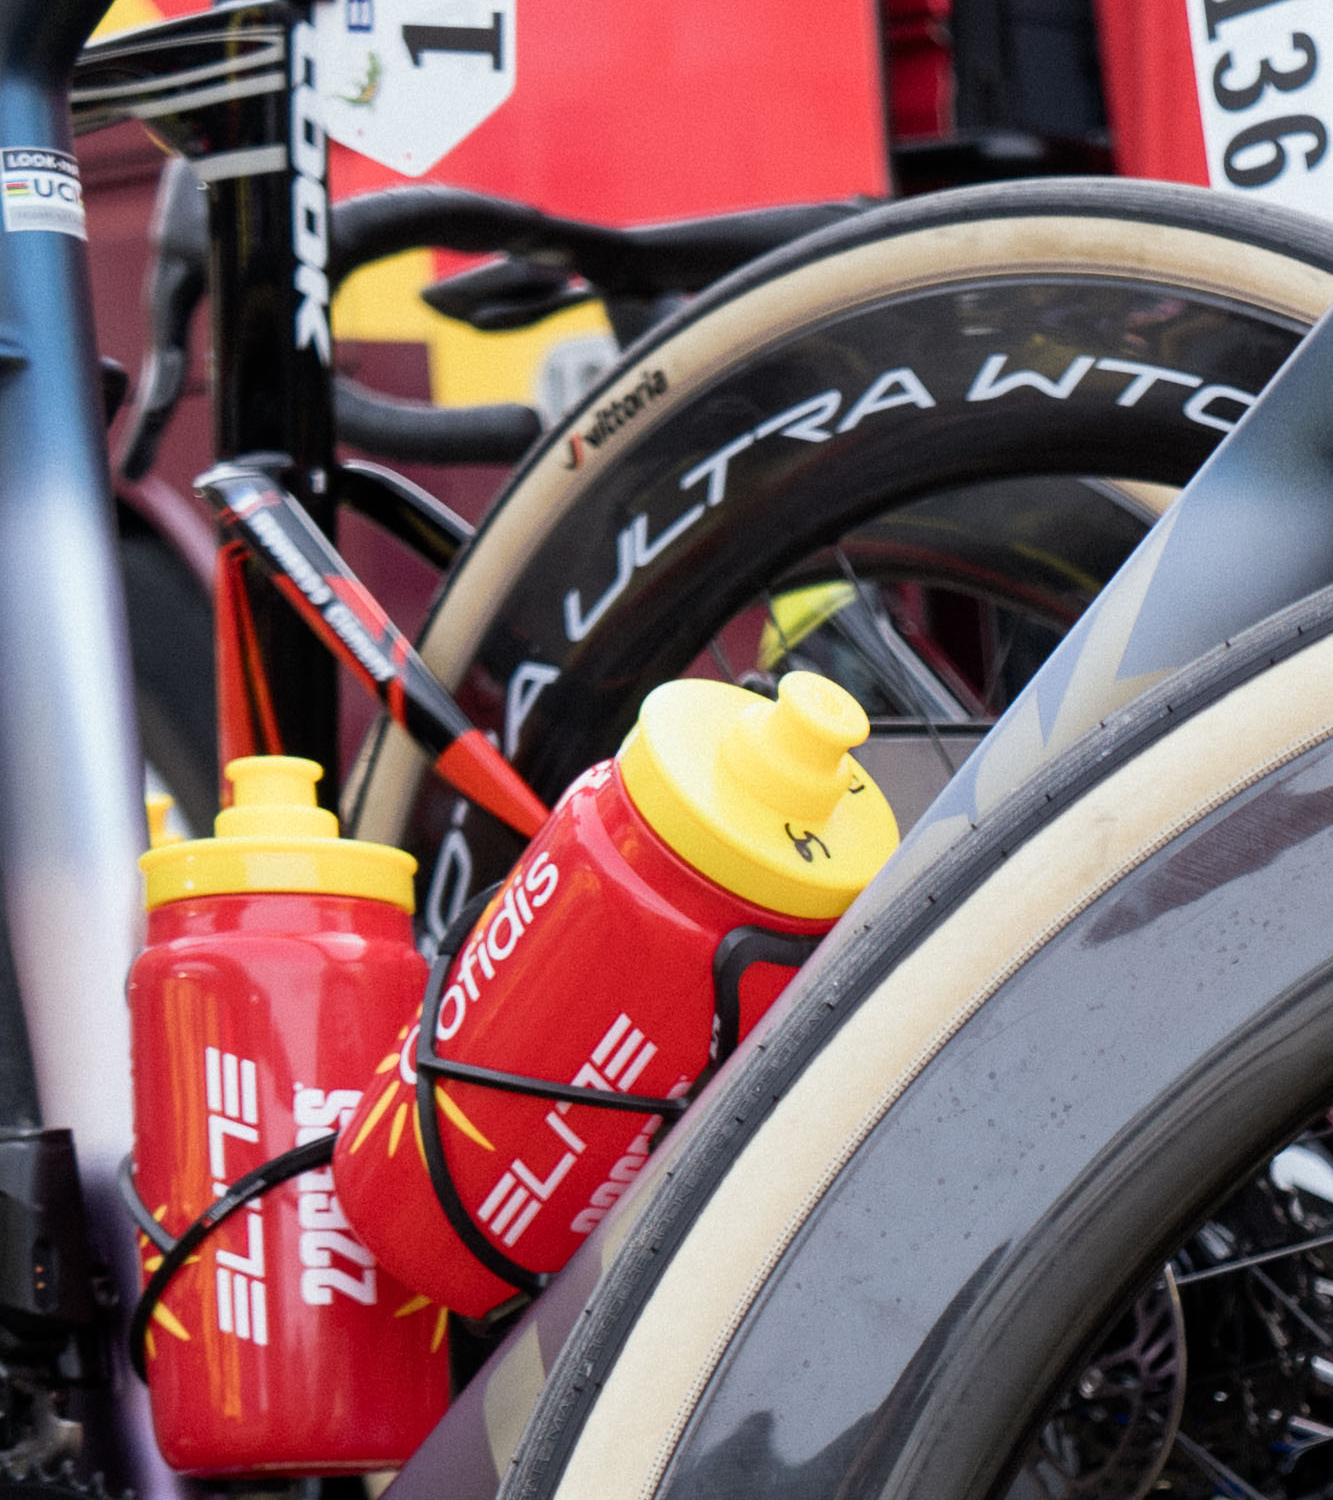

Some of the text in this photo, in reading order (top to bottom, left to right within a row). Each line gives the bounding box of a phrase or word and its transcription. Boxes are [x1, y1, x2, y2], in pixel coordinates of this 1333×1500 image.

[290, 4, 331, 366] LOOK
[564, 366, 935, 640] ULTRA
[584, 367, 668, 448] vittoria
[478, 1013, 658, 1246] ELITE
